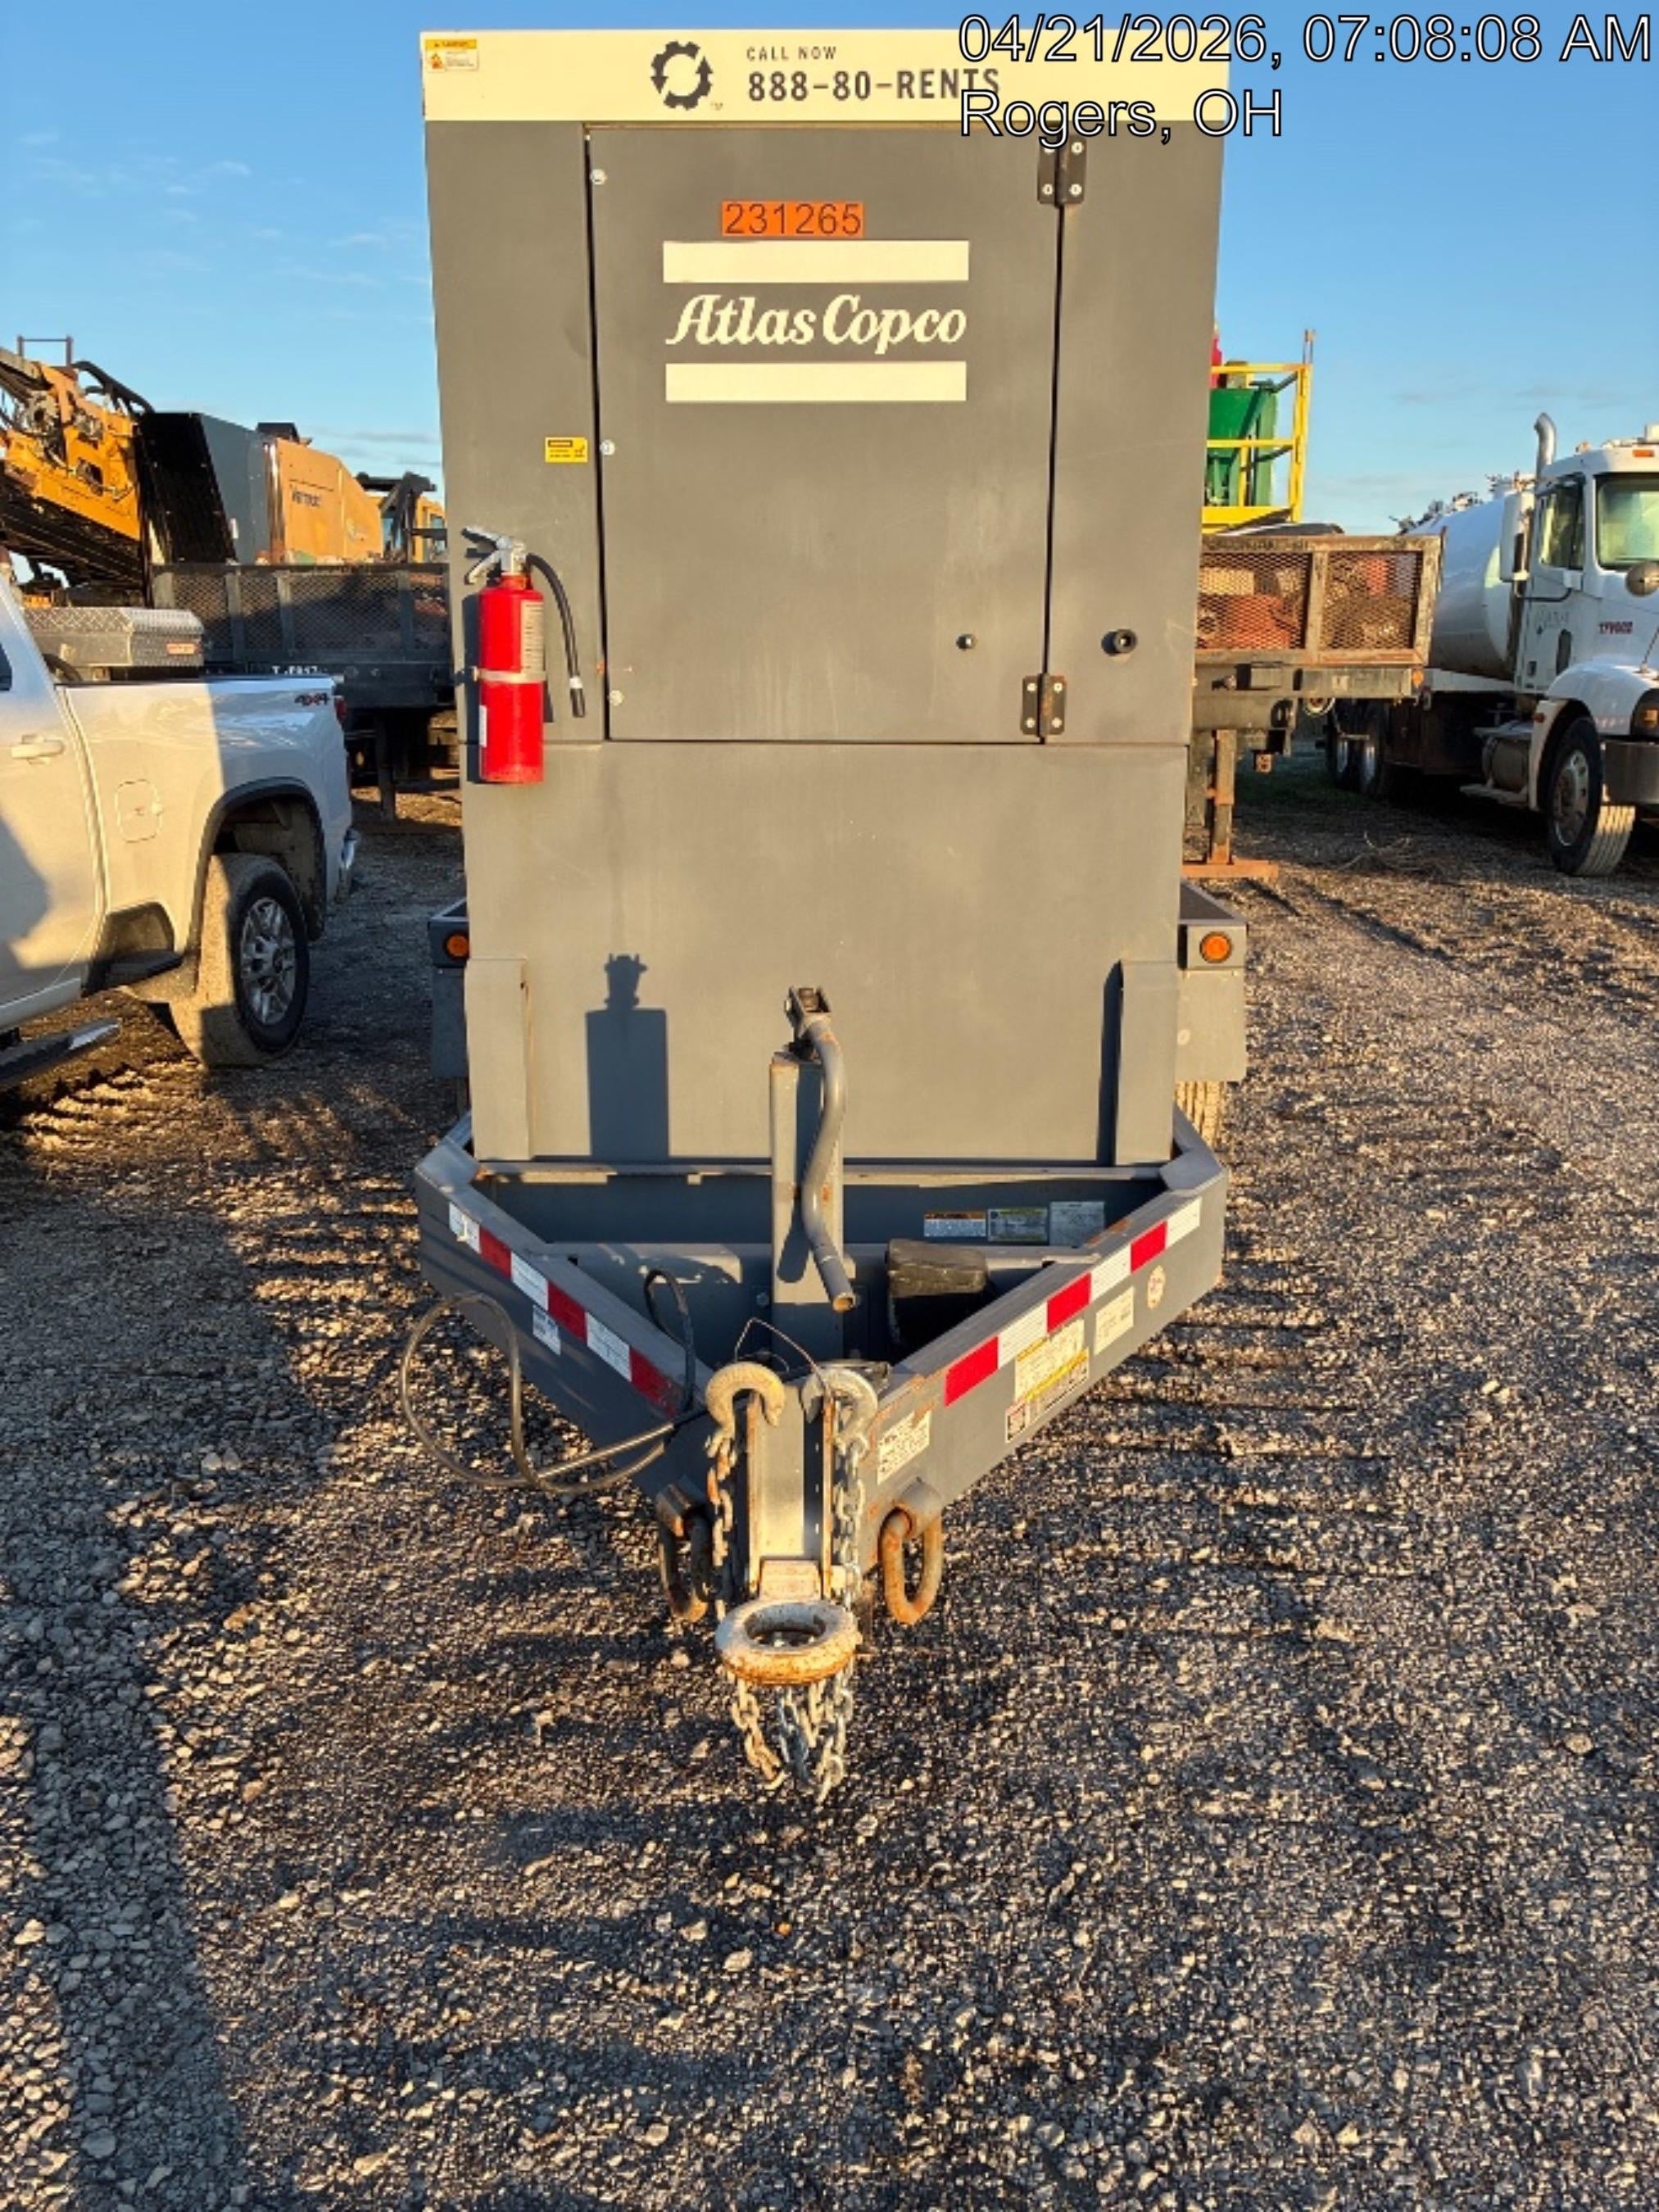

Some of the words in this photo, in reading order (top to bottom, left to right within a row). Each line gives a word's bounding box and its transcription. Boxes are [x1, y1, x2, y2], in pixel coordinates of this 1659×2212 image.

[746, 46, 790, 61] CALL
[798, 46, 837, 61] NOW
[724, 202, 863, 236] 231265
[664, 293, 818, 346] Atlas
[822, 293, 968, 356] Copco
